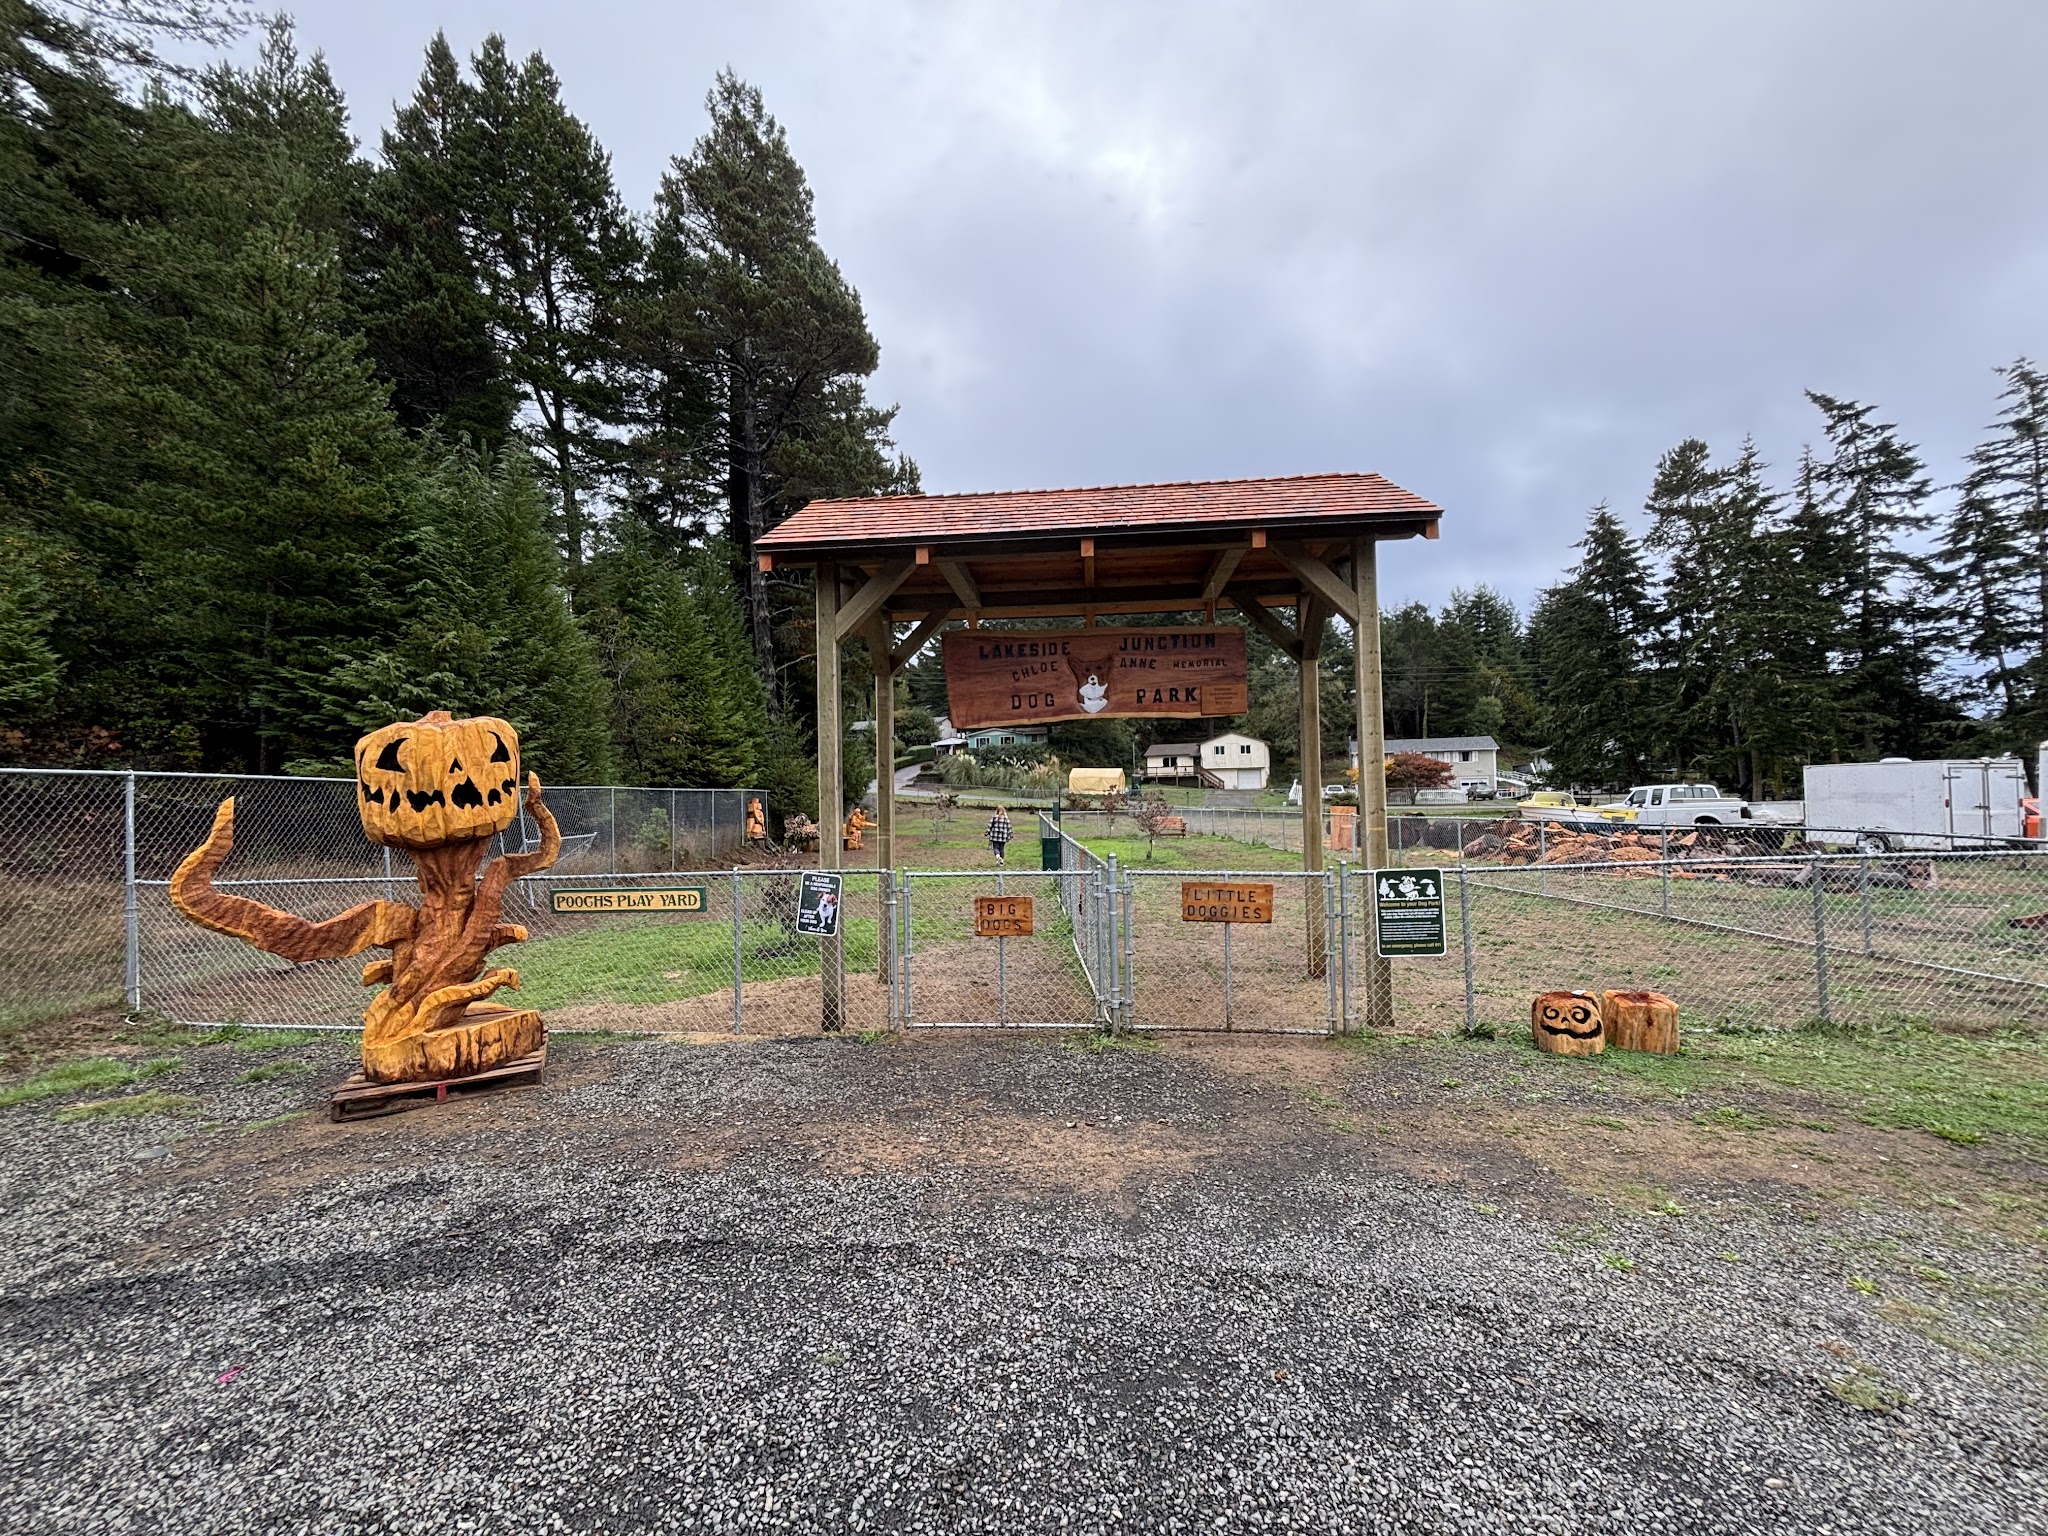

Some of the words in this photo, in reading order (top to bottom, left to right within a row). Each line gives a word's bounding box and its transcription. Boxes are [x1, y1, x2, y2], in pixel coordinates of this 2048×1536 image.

[978, 641, 1071, 660] LAKESIDE
[1119, 633, 1216, 651] JUNCTION
[1012, 660, 1058, 682] CHLOE
[1120, 657, 1157, 669] ANNE
[1173, 658, 1228, 669] MEMORIAL
[1010, 692, 1055, 710] DOG
[1136, 687, 1198, 704] PARK
[556, 895, 613, 908] POOCHS
[617, 895, 653, 907] PLAY
[659, 894, 698, 906] YARD
[1194, 889, 1257, 903] LITTLE
[987, 903, 1016, 915] BIG
[1187, 905, 1262, 919] DOGGIES
[982, 919, 1022, 931] DOGS
